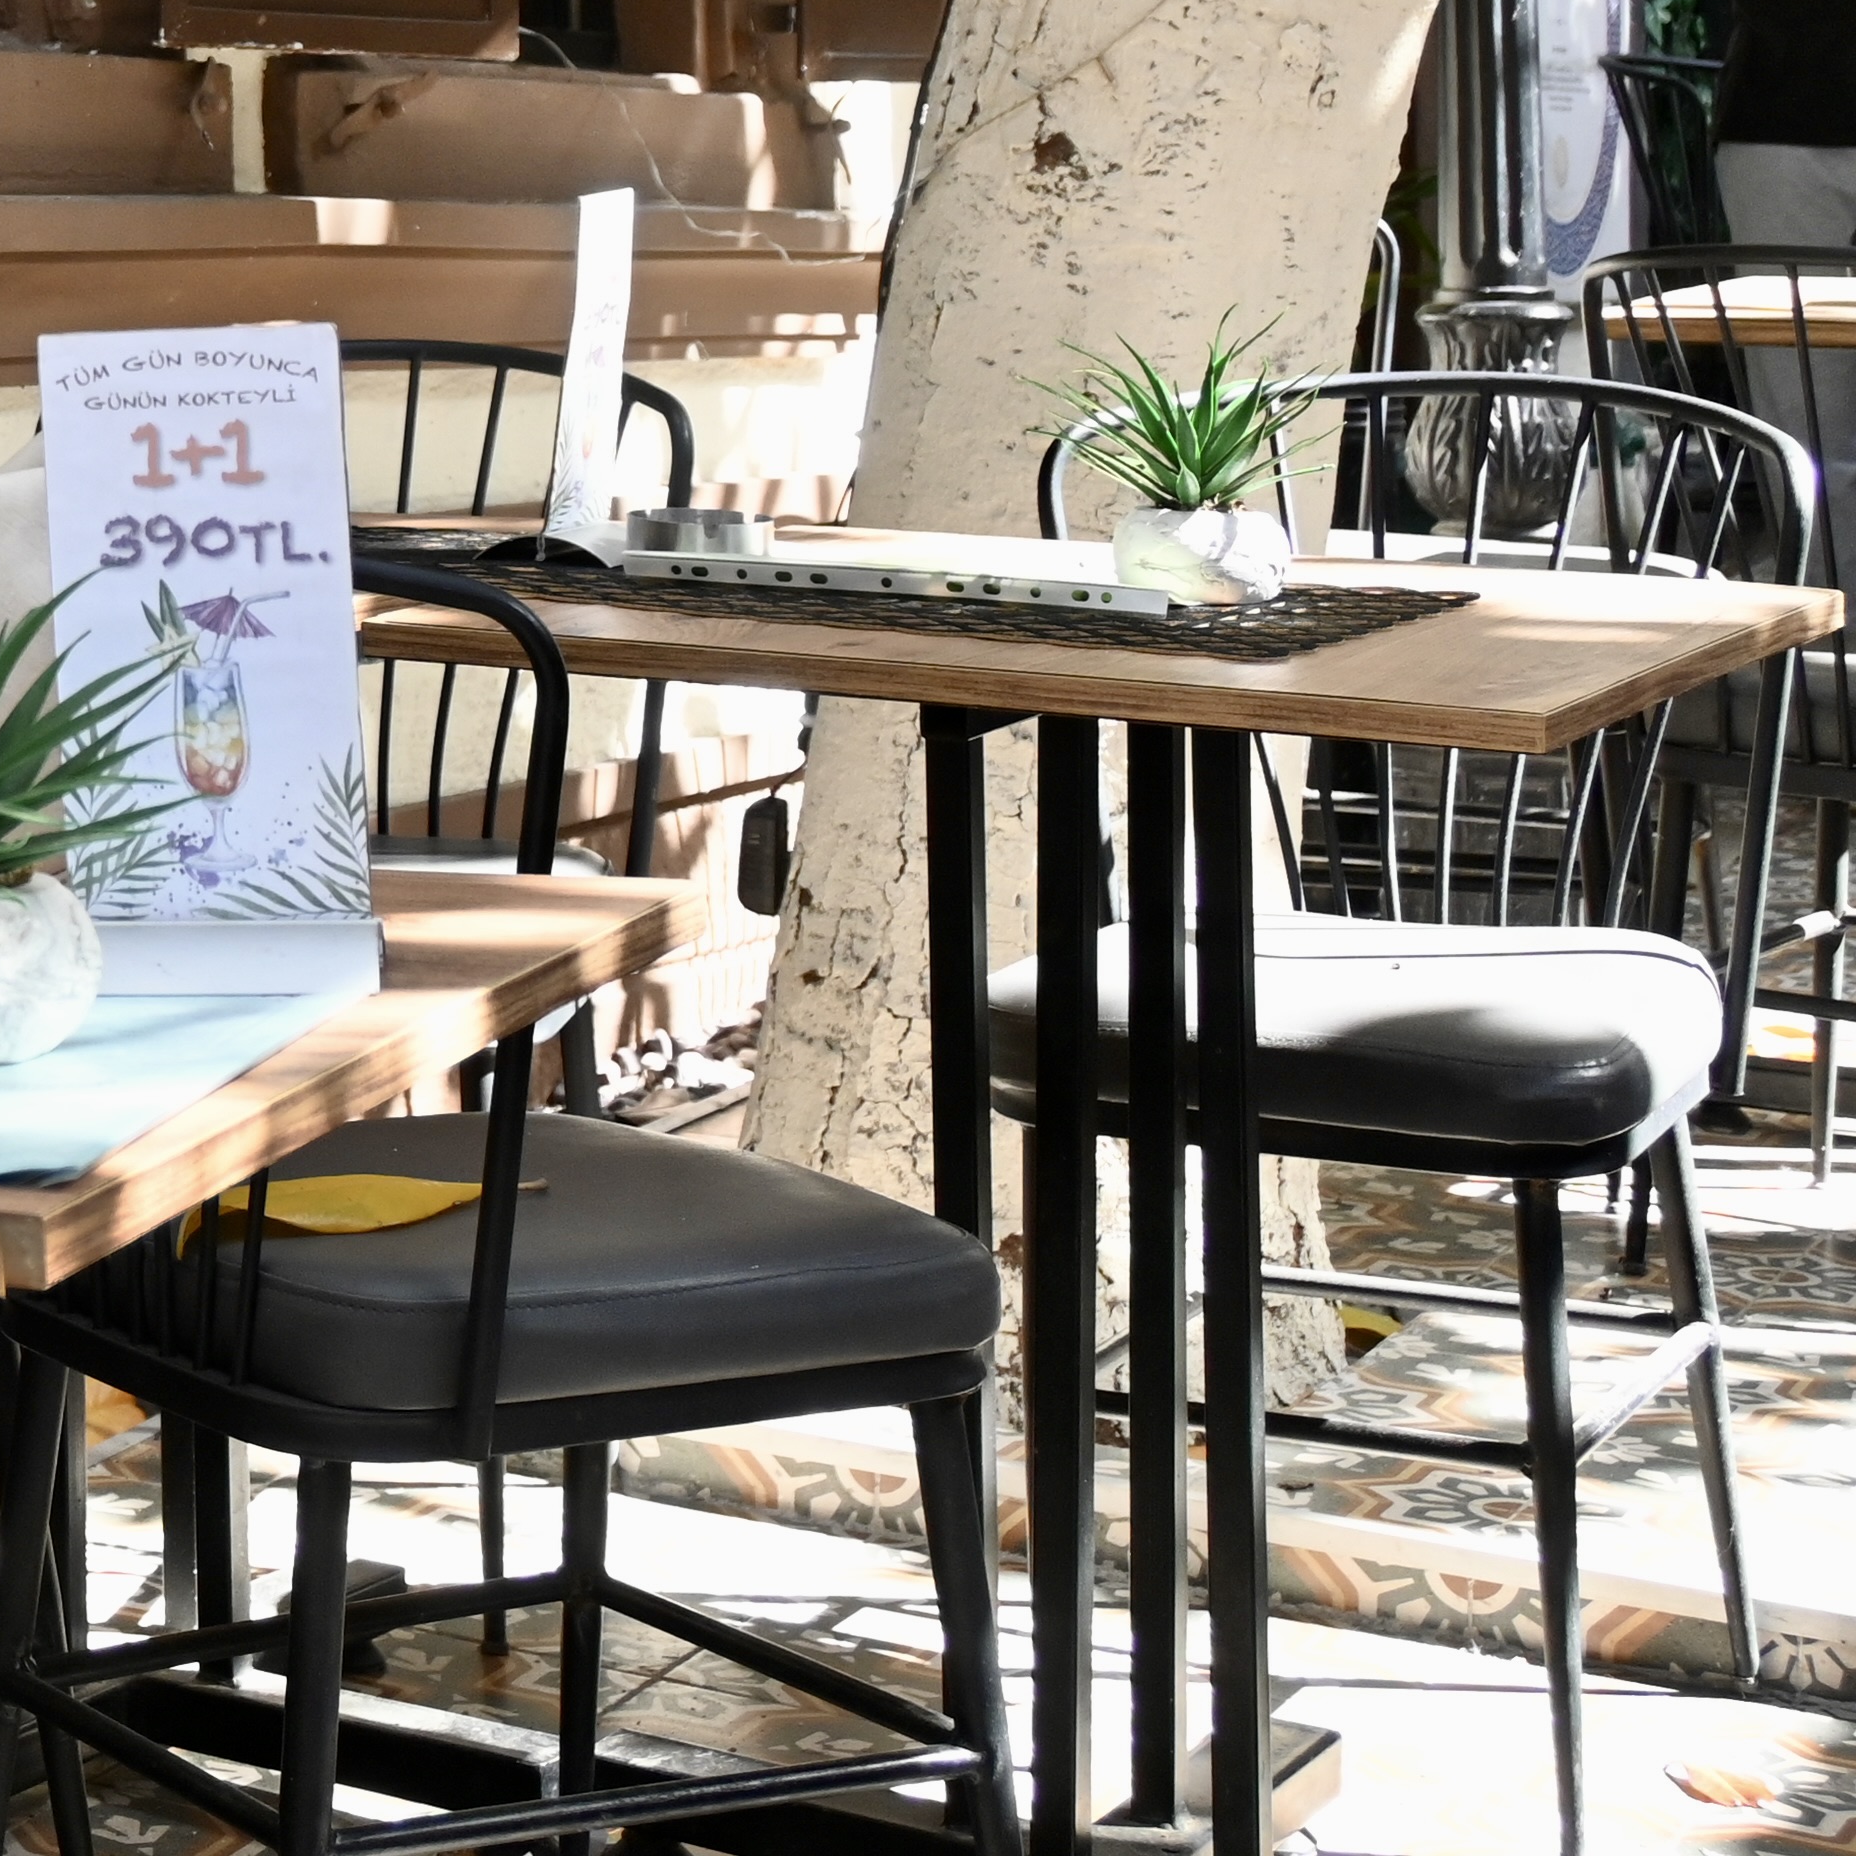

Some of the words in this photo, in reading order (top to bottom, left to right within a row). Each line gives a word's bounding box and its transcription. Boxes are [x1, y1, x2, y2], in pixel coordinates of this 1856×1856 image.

[55, 364, 110, 392] TÜM
[121, 349, 182, 373] GÜN
[194, 350, 319, 383] BOYUNCA
[83, 392, 167, 411] GÜNÜN
[177, 384, 297, 407] KOKTEYLİ
[131, 418, 266, 488] 1+1
[99, 514, 333, 568] 390TL.
